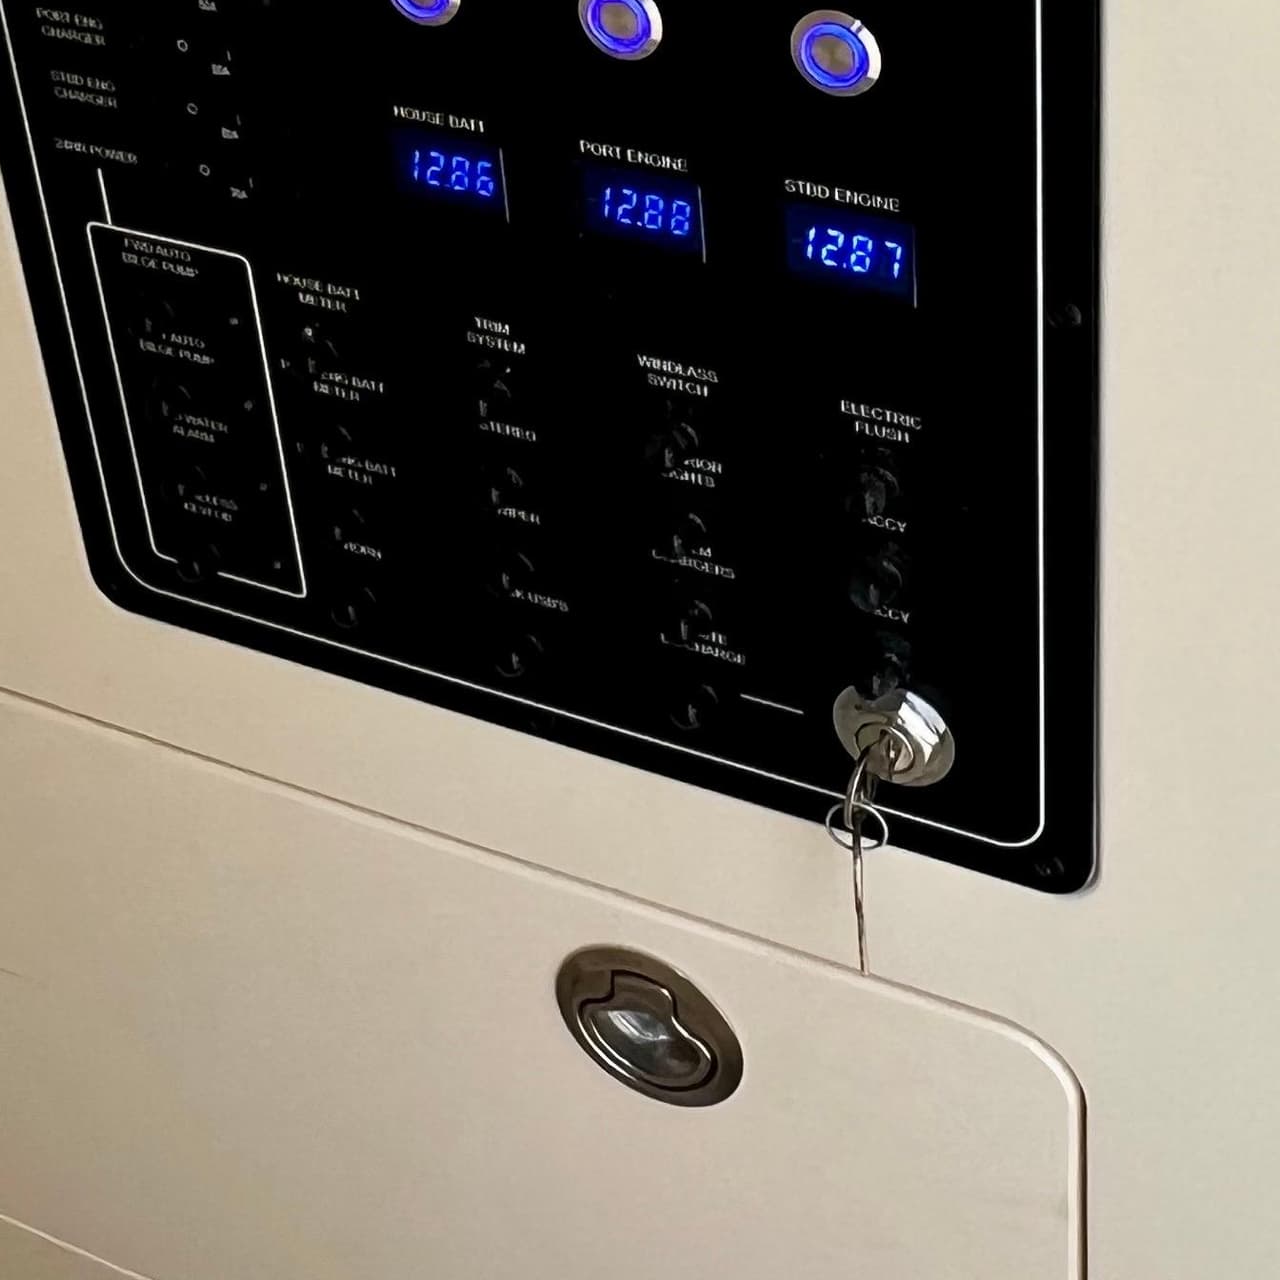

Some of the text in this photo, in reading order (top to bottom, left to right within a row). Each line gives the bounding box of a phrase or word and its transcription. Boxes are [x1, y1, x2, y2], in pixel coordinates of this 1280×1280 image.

[393, 105, 445, 126] HOUSE
[579, 139, 689, 172] PORT ENGINE
[604, 187, 691, 236] 12.88
[784, 179, 901, 212] STBD ENGINE
[806, 226, 902, 279] 12.87
[636, 353, 720, 384] WINDLASS
[647, 372, 709, 398] SWITCH
[840, 399, 923, 431] ELECTRIC
[854, 420, 911, 444] FLUSH
